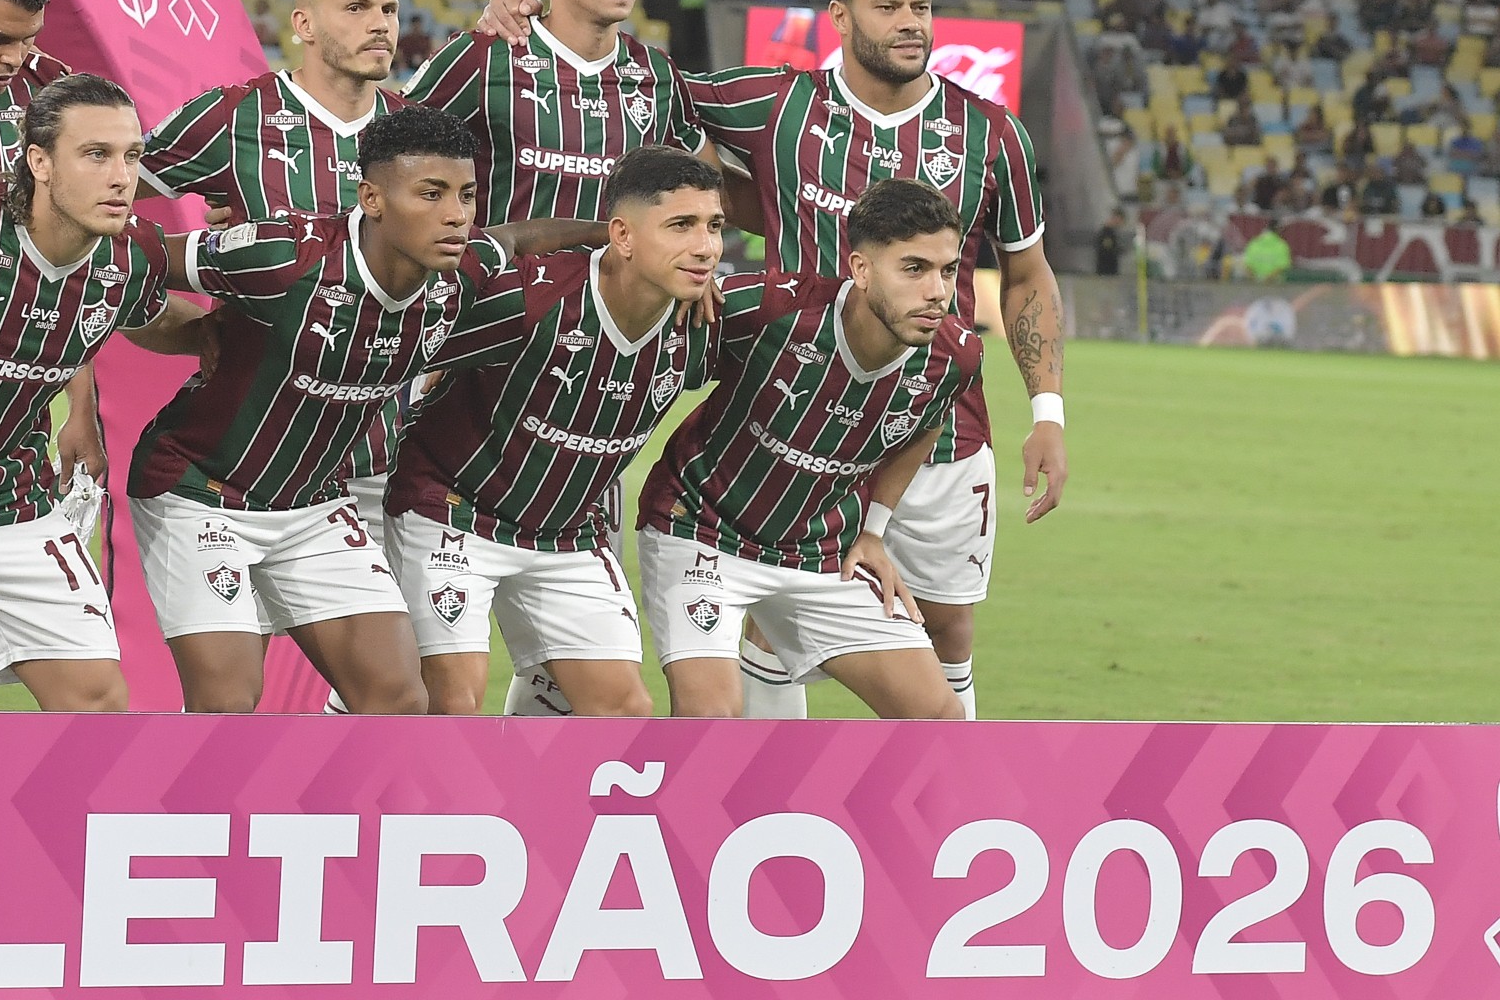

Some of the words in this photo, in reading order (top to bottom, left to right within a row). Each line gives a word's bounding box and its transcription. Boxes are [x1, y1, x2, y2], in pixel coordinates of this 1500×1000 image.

[514, 58, 548, 68] FRESCATTO
[571, 94, 608, 110] Leve
[267, 116, 303, 124] FRESCATTO
[926, 122, 960, 134] FRESCATTO
[862, 140, 903, 160] Leve
[327, 157, 362, 173] Leve
[519, 148, 615, 175] SUPERSC
[94, 270, 125, 282] FRESCATTO
[319, 289, 354, 303] FRESCATTO
[429, 285, 456, 299] FRESCATTO
[21, 303, 61, 321] Leve
[35, 320, 57, 331] saúde
[364, 336, 401, 350] Leve
[559, 335, 593, 346] FRESCATTO
[789, 342, 825, 363] FRESCATTO
[293, 374, 400, 401] SUPERSCO
[598, 377, 635, 393] Leve
[902, 378, 933, 391] FRESCATTO
[611, 392, 632, 401] saúde
[825, 399, 865, 420] Leve
[523, 415, 653, 455] SUPERSCOR
[750, 420, 880, 476] SUPERSCOR
[972, 482, 990, 537] 7
[198, 531, 236, 544] MEGA
[44, 532, 100, 592] 17
[430, 552, 470, 567] MEGA
[684, 569, 723, 584] MEGA
[925, 818, 1436, 979] 2026
